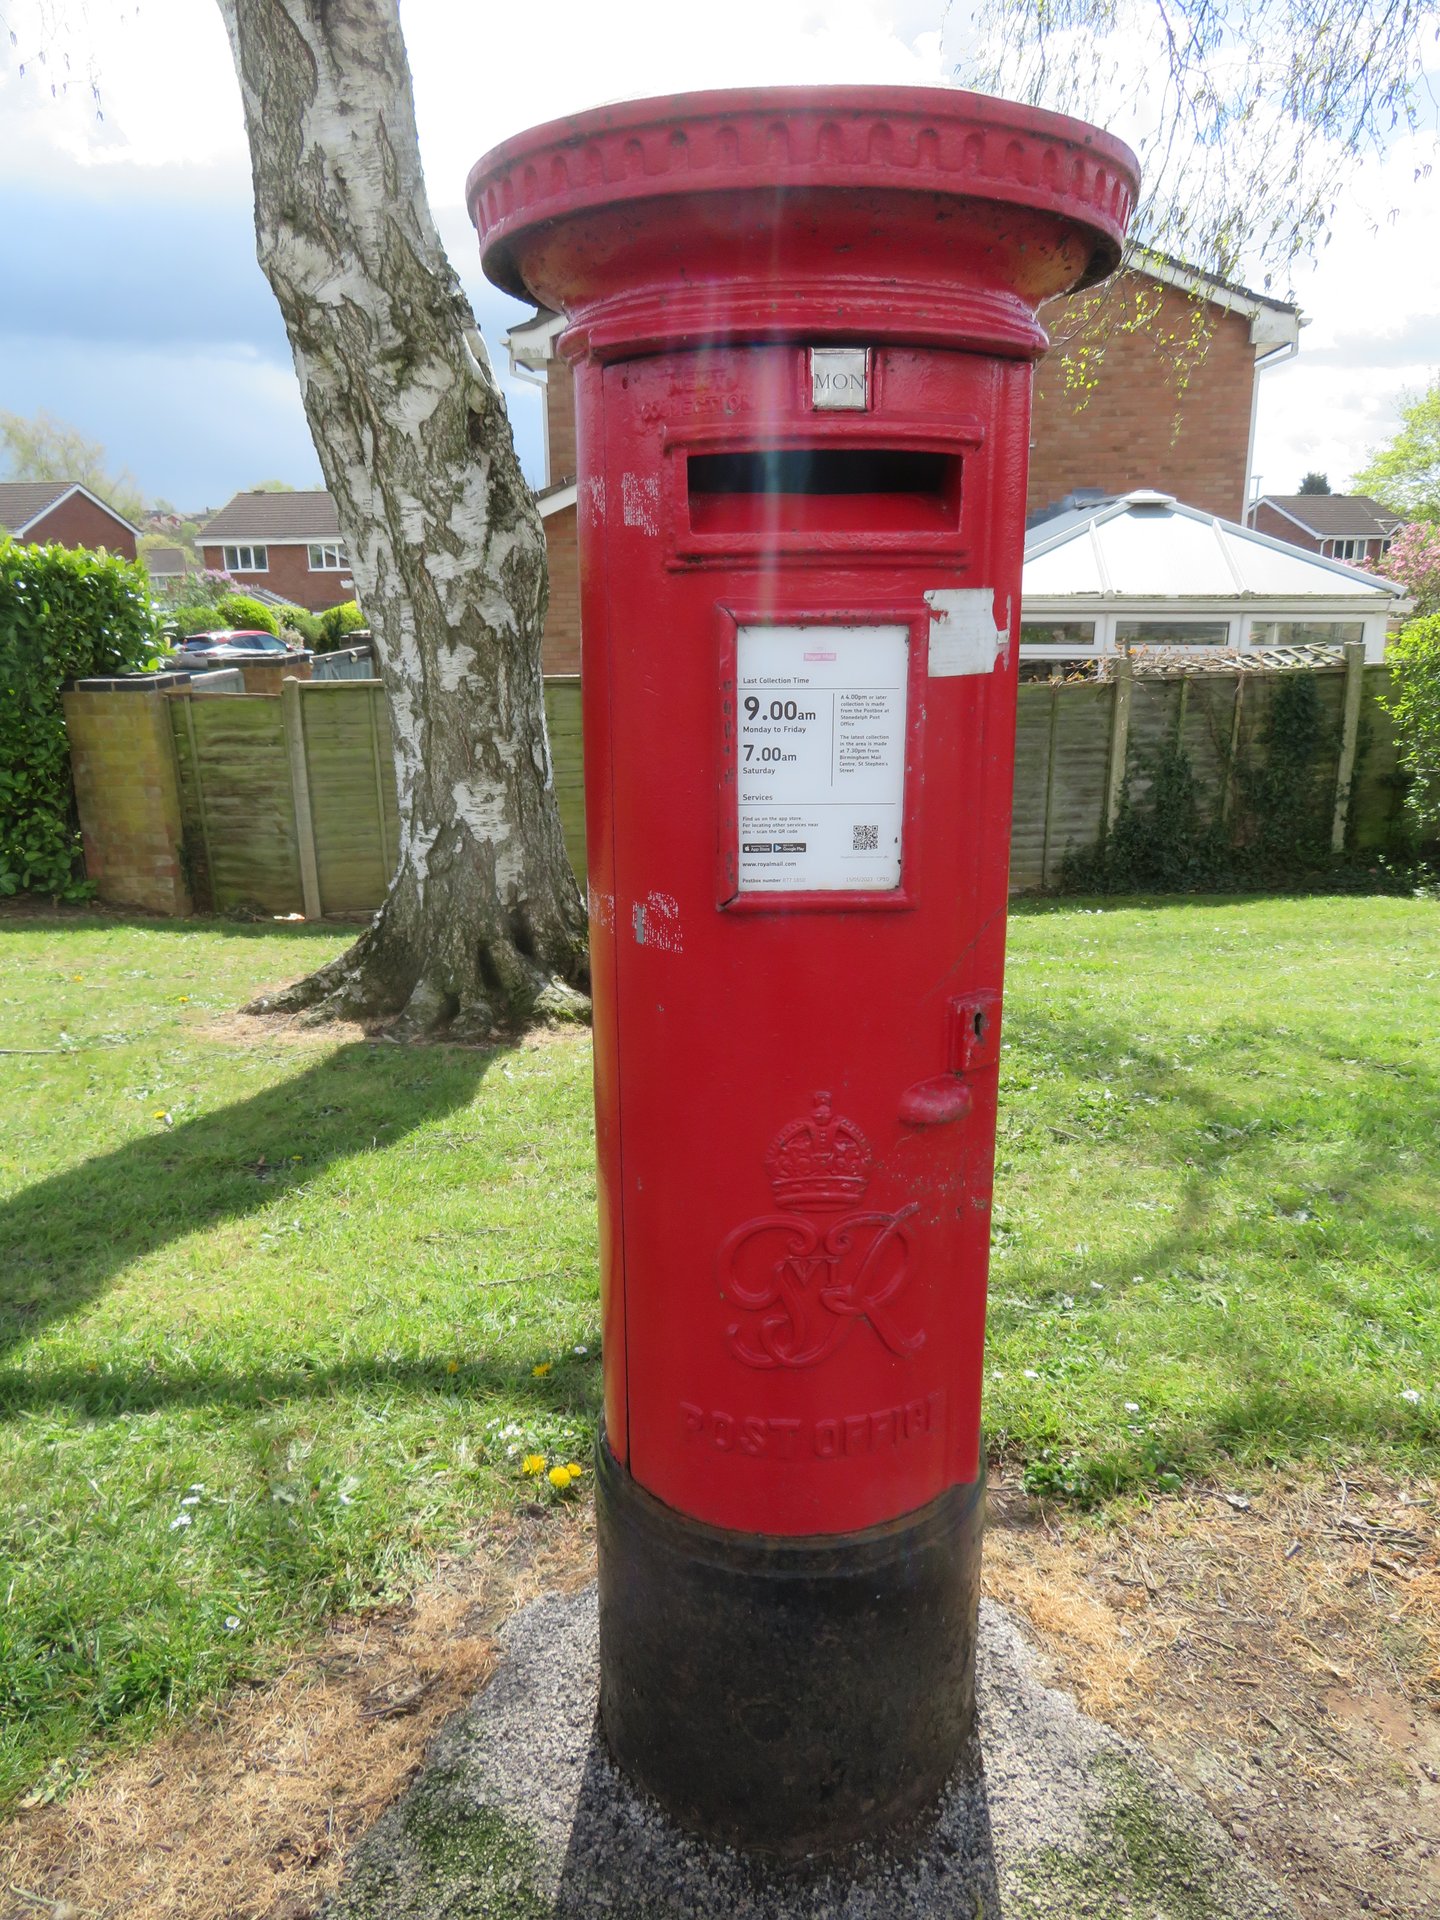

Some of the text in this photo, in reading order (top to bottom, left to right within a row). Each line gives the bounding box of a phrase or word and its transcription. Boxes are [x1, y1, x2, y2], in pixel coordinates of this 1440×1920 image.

[814, 373, 864, 390] MON
[744, 696, 816, 721] 9.00am
[743, 726, 771, 734] Monday
[783, 726, 806, 734] Friday
[743, 744, 797, 762] 7.00am
[742, 767, 776, 775] Saturday
[742, 793, 773, 801] Services
[679, 1400, 802, 1459] POST
